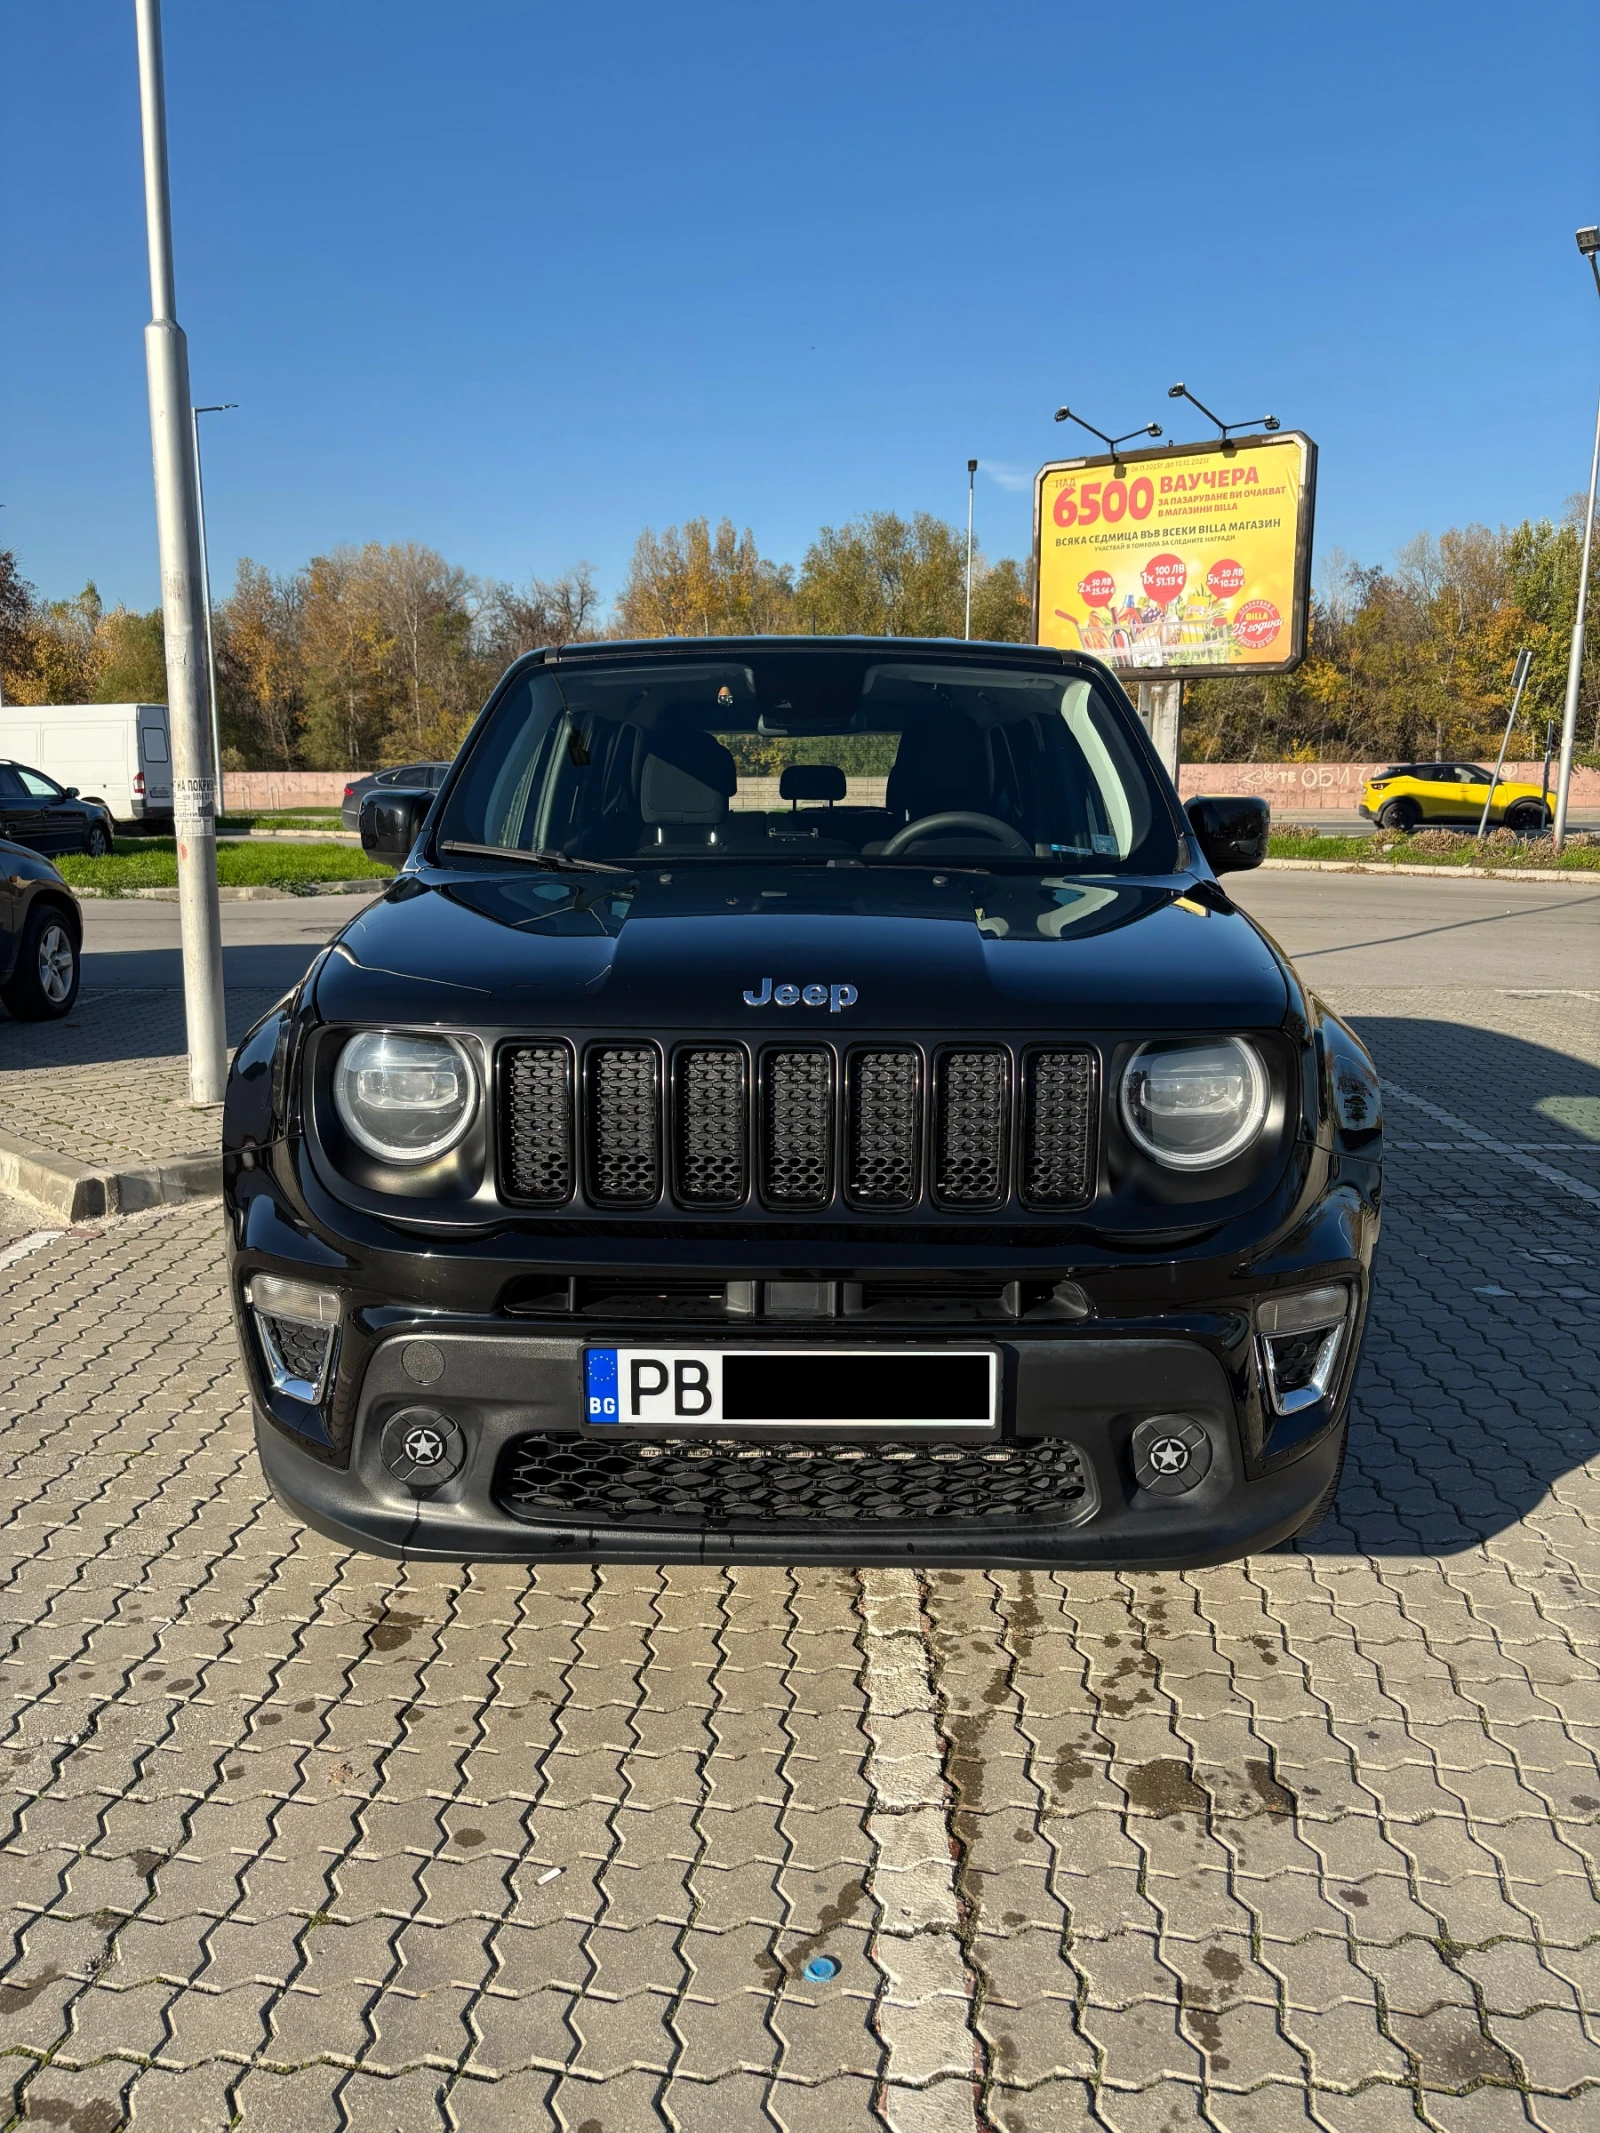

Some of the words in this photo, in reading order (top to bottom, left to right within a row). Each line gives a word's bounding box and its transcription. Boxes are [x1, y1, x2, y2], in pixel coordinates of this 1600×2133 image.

[1055, 478, 1076, 488] НАД
[1160, 466, 1259, 494] ВАУЧЕРА
[1053, 476, 1155, 528] 6500
[1158, 498, 1169, 507] ЗА
[1170, 492, 1228, 505] ПАЗАРУВАНЕ
[1229, 491, 1242, 499] ВИ
[1244, 486, 1286, 497] ОЧАКВАТ
[1158, 509, 1164, 517] В
[1165, 505, 1212, 517] МАГАЗИНИ
[1214, 503, 1238, 512] BILLA
[1055, 536, 1087, 547] ВСЯКА
[1089, 531, 1138, 544] СЕДМИЦА
[1140, 529, 1160, 539] ВЪВ
[1162, 526, 1196, 537] ВСЕКИ
[1198, 523, 1226, 534] BILLA
[1228, 518, 1281, 532] МАГАЗИН
[1094, 543, 1125, 552] УЧАСТВАЙ
[1170, 537, 1204, 546] СЛЕДНИТЕ
[1205, 535, 1236, 543] НАГРАДИ
[1154, 565, 1171, 576] 100
[1171, 563, 1185, 574] ЛВ
[1221, 569, 1231, 577] 20
[1231, 567, 1244, 577] ЛВ
[1091, 578, 1101, 587] 50
[1101, 577, 1112, 586] ЛВ
[1155, 576, 1176, 587] 51.13
[1220, 578, 1239, 588] 10.23
[1245, 612, 1269, 621] BILLA
[1230, 621, 1248, 636] 25
[1247, 617, 1284, 635] години
[743, 977, 859, 1013] Jeep
[589, 1397, 616, 1415] BG
